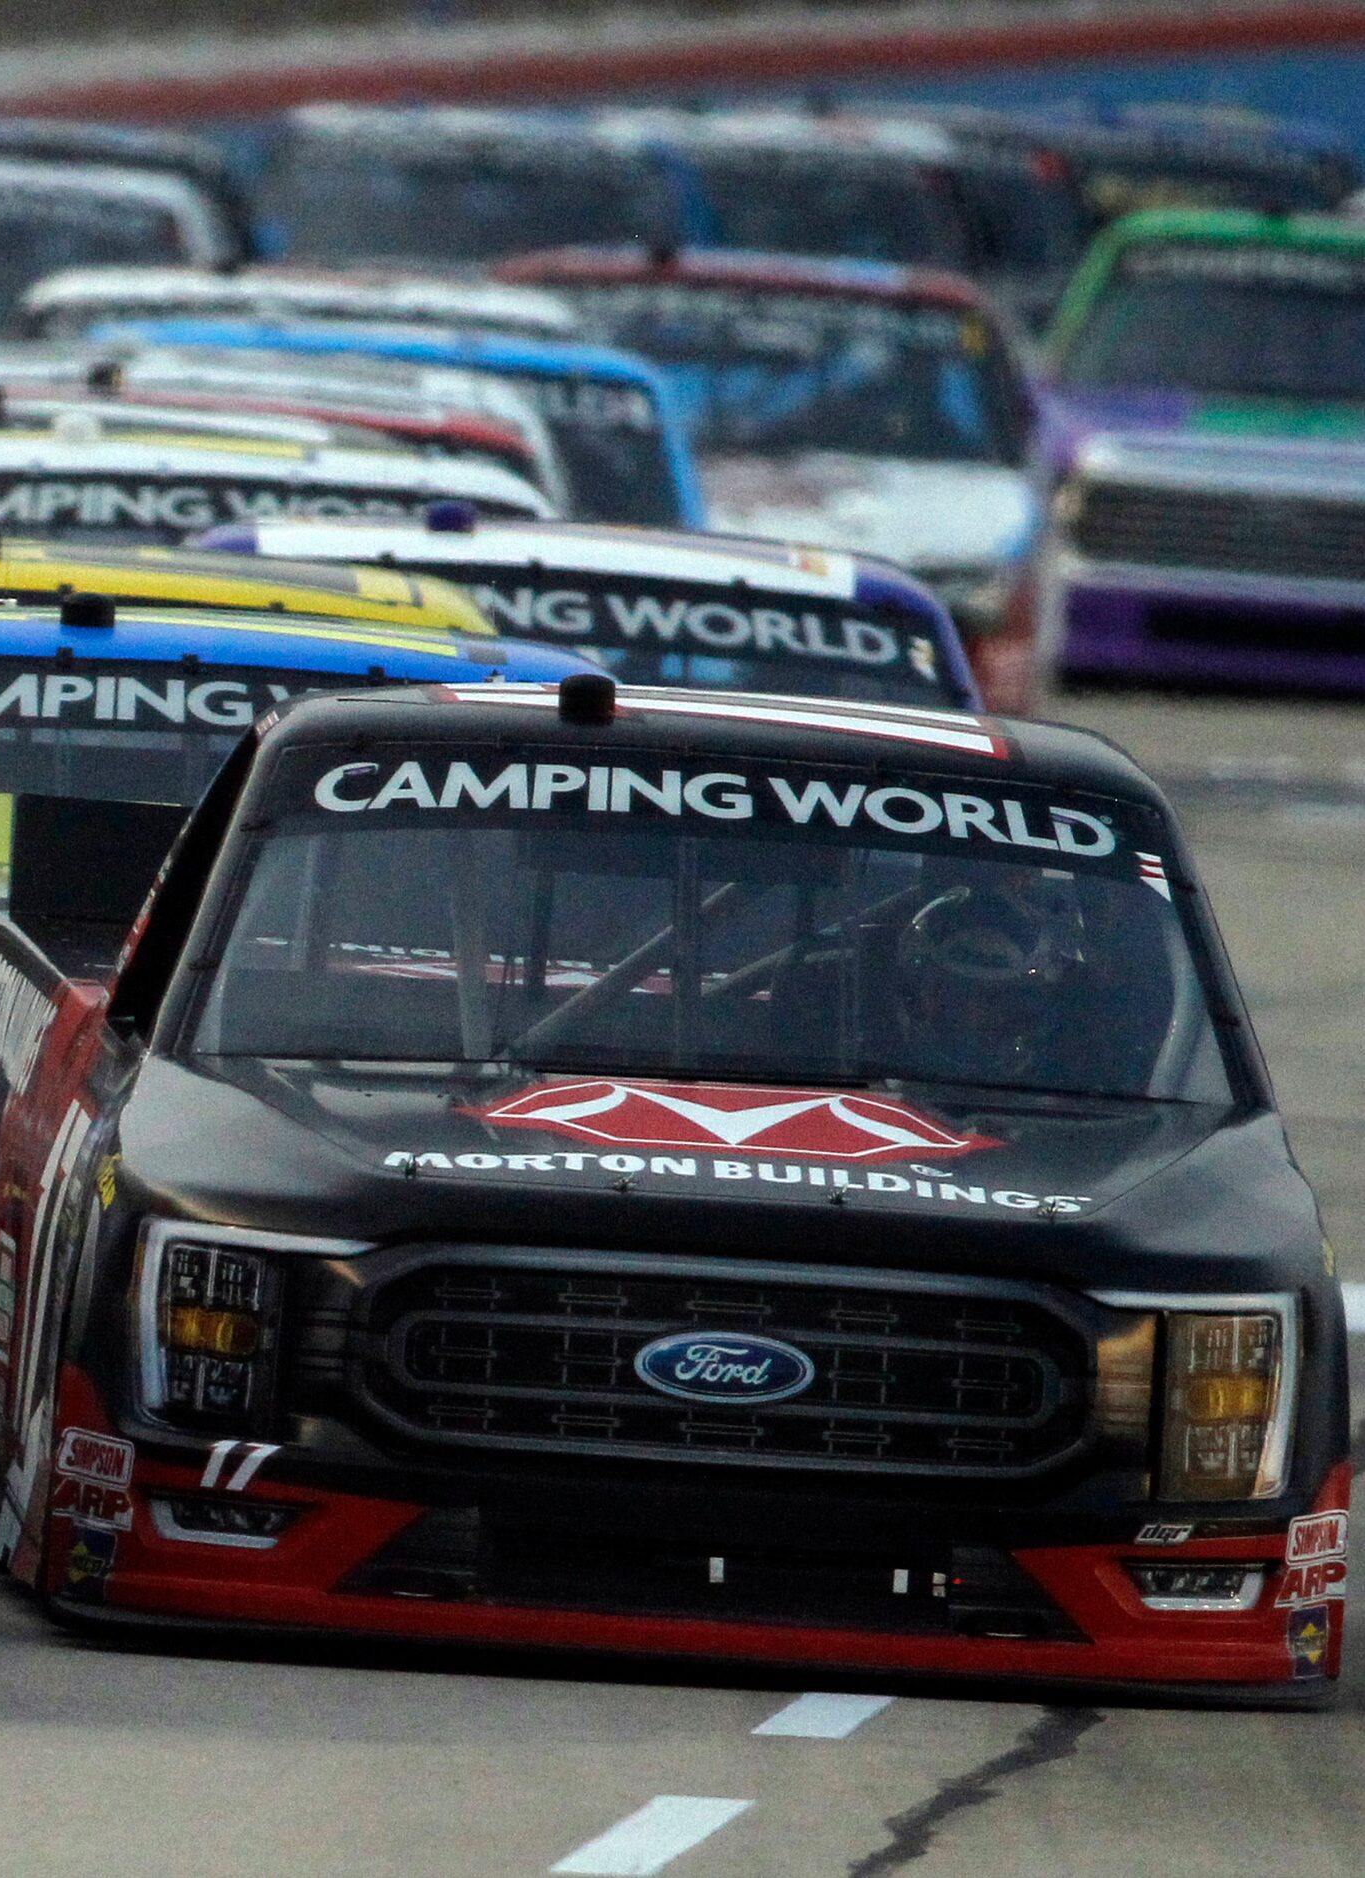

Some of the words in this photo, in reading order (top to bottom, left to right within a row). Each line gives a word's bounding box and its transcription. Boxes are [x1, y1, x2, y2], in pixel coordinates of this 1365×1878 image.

[603, 594, 899, 665] WORLD
[316, 761, 753, 819] CAMPING
[769, 776, 1116, 858] WORLD
[383, 1150, 697, 1177] MORTON
[713, 1156, 1093, 1214] BUILDINGS
[673, 1332, 771, 1387] Ford
[65, 1436, 127, 1480] SIMPSON
[199, 1439, 283, 1492] 17
[52, 1478, 133, 1522] ARP
[1291, 1517, 1341, 1556] SIMPSON
[1276, 1561, 1348, 1604] ARP
